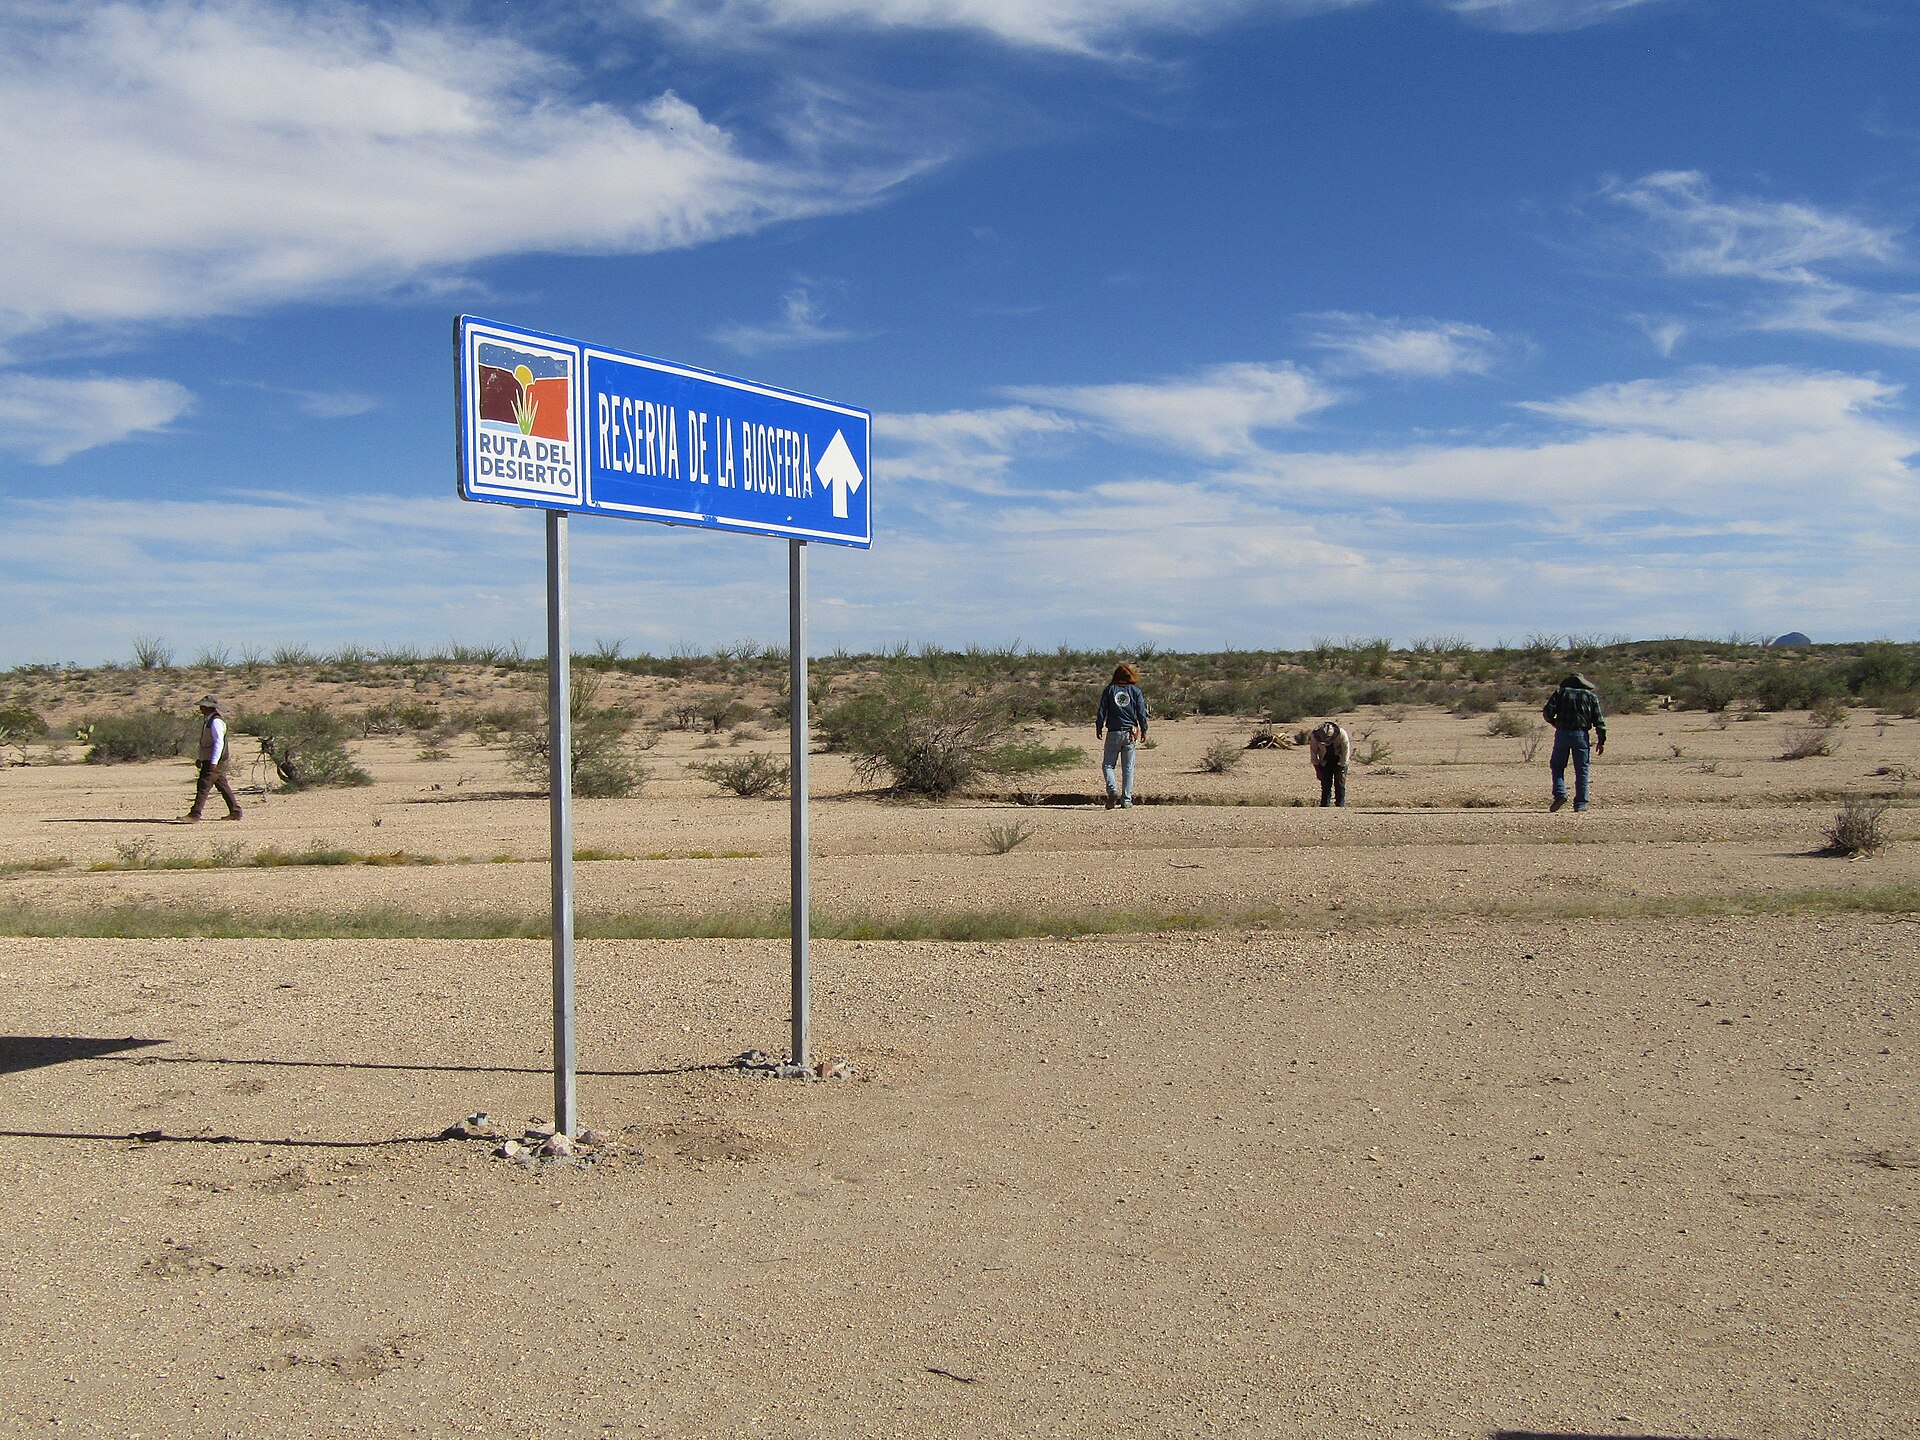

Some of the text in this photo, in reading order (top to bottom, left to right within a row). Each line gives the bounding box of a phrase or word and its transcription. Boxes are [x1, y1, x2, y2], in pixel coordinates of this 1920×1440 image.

[479, 432, 572, 467] RUTA DEL
[598, 392, 813, 499] RESERVA DE LA BIOSFERA
[480, 455, 572, 487] DESIERTO
